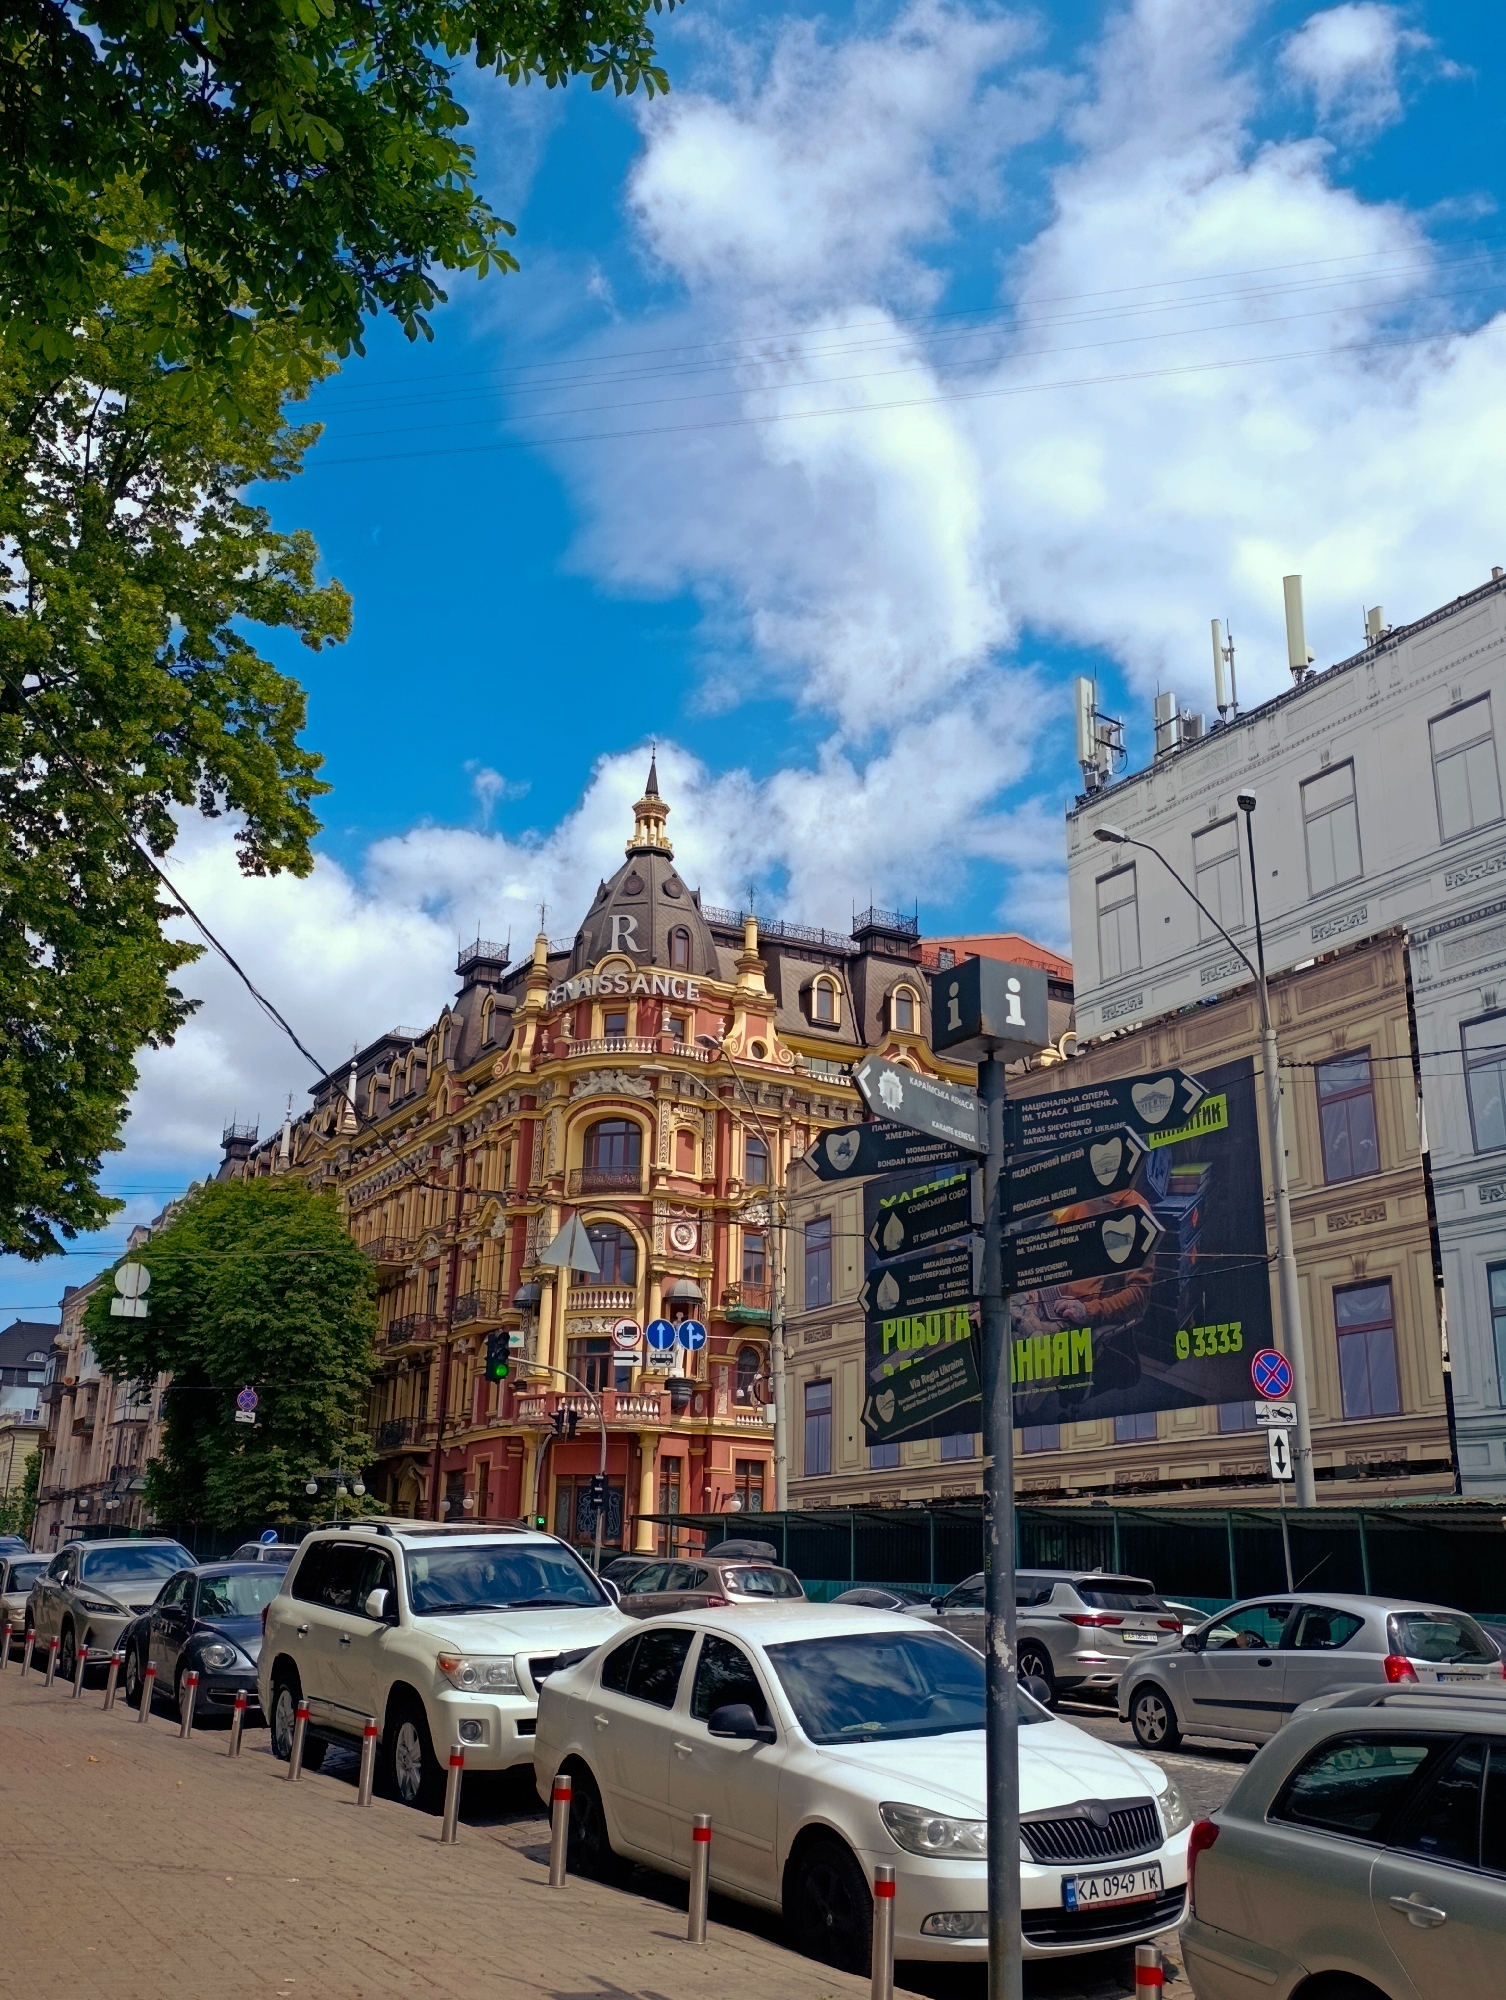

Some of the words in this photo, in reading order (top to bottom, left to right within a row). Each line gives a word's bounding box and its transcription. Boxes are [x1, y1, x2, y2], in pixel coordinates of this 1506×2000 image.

[606, 914, 648, 953] R
[546, 972, 700, 1011] RENAISSANCE
[909, 1077, 950, 1101] КАРАЇМСЬКА
[1022, 1095, 1080, 1112] НАЦІОНАЛЬНА
[1082, 1089, 1110, 1101] ОПЕРА
[1022, 1113, 1034, 1122] ІМ.
[1036, 1107, 1069, 1119] ТАРАСА
[1073, 1098, 1118, 1113] ШЕВЧЕНКА
[1023, 1126, 1046, 1136] TARAS
[1047, 1118, 1092, 1133] SHEVCHENKO
[1023, 1134, 1058, 1146] NATIONAL
[1059, 1130, 1082, 1141] OPERA
[1084, 1128, 1094, 1136] OF
[906, 1143, 947, 1155] MONUMENT
[878, 1158, 906, 1168] BOHDAN
[1012, 1155, 1060, 1180] ПЕДАГОГІЧНИЙ
[1061, 1148, 1085, 1163] МУЗЕЙ
[1012, 1195, 1051, 1213] PEDAGOGICAL
[1051, 1186, 1077, 1201] MUSEUM
[940, 1220, 970, 1236] CATHEDRA
[1017, 1228, 1059, 1245] НАЦІОНАЛЬНИЙ
[1026, 1242, 1048, 1253] ТАРАСА
[1048, 1235, 1079, 1248] ШЕВЧЕНКА
[1193, 1322, 1243, 1357] 3333
[1079, 1879, 1099, 1900] KA
[1103, 1873, 1135, 1897] 0949
[1142, 1869, 1159, 1890] IK
